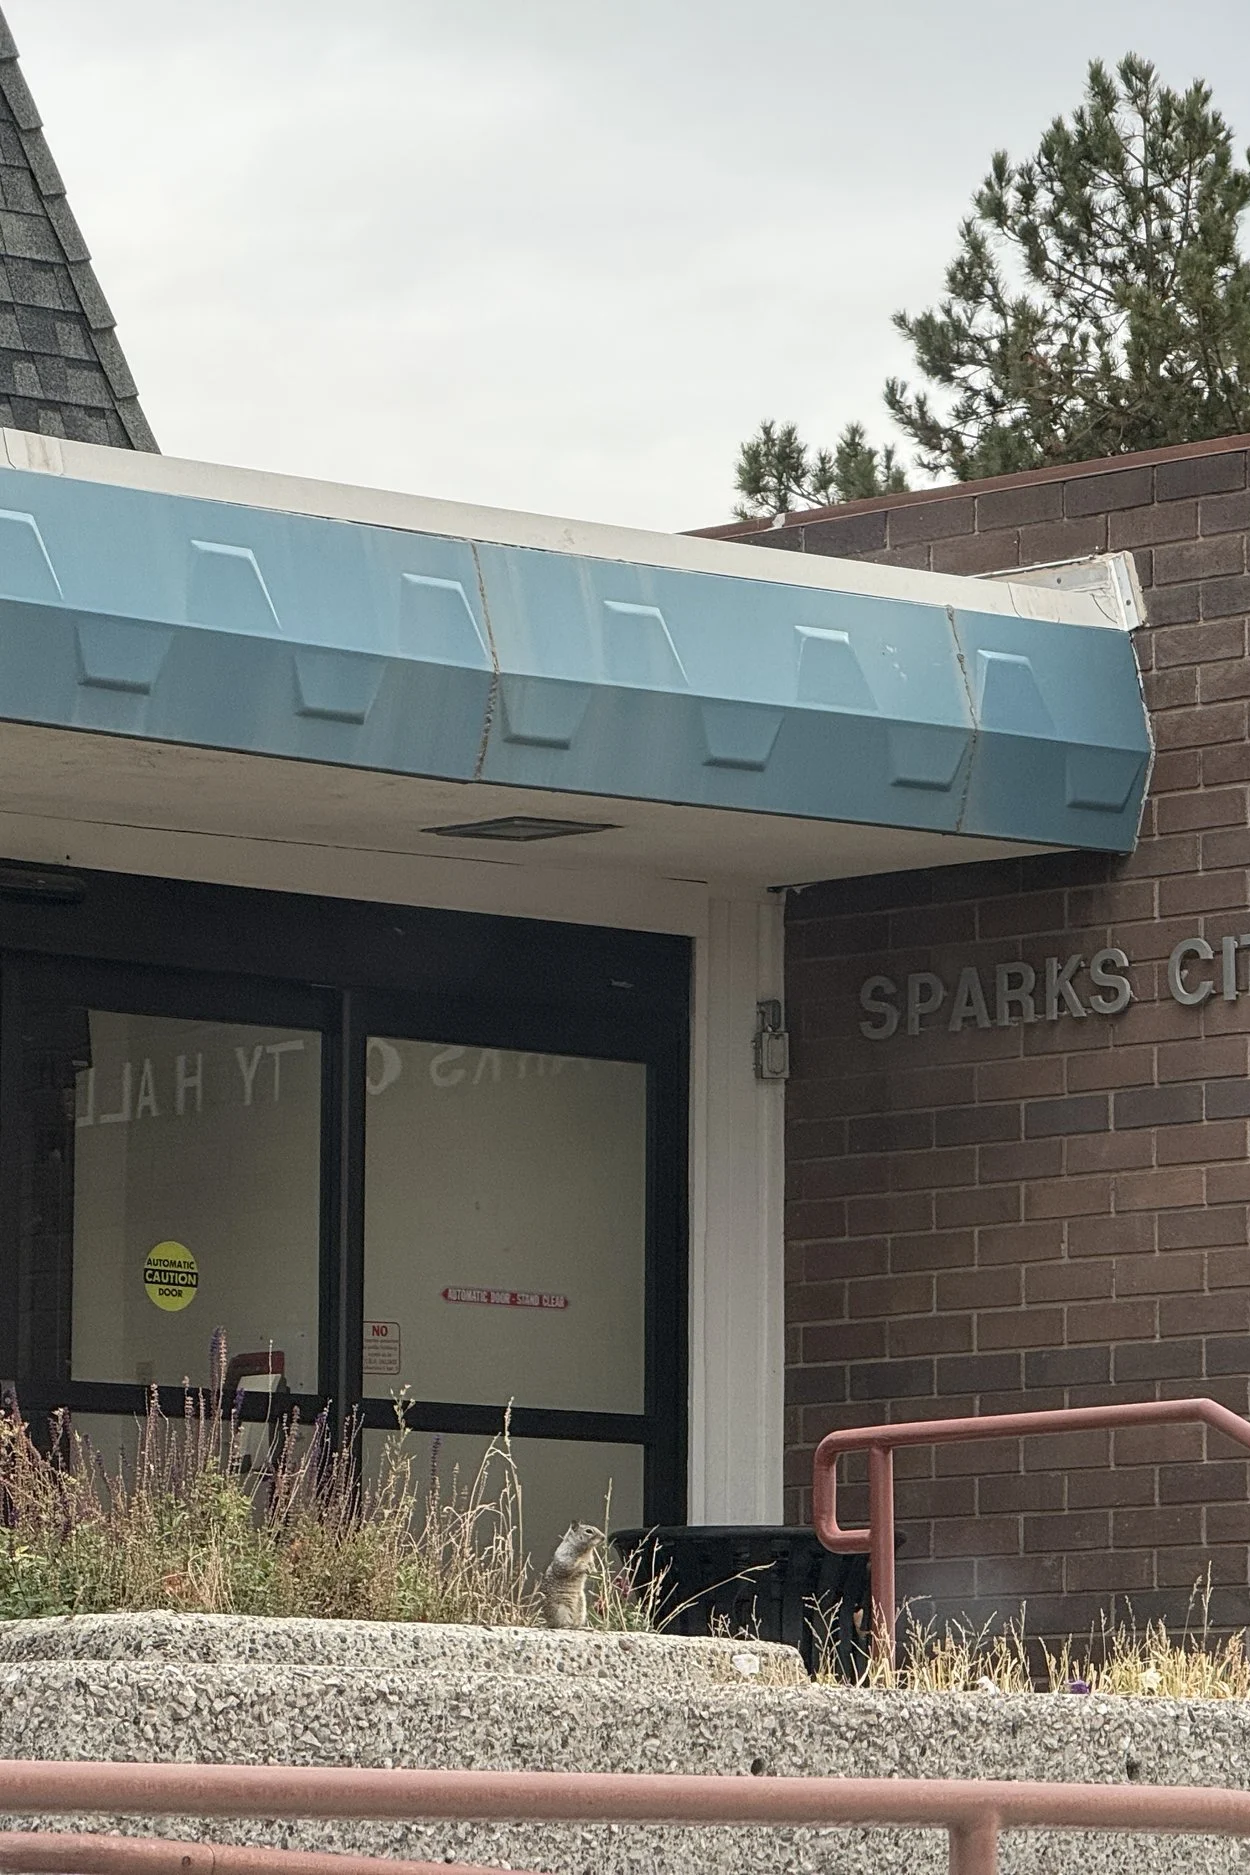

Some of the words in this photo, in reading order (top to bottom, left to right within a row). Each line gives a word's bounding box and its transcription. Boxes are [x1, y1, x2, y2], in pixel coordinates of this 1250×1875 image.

[858, 946, 1134, 1041] SPARKS
[147, 1258, 194, 1269] AUTOMATIC
[145, 1270, 197, 1285] CAUTION
[158, 1287, 183, 1298] DOOR
[448, 1288, 488, 1302] AUTOMATIC
[517, 1293, 540, 1305] STAND
[542, 1295, 565, 1308] CLEAR
[372, 1325, 388, 1337] NO
